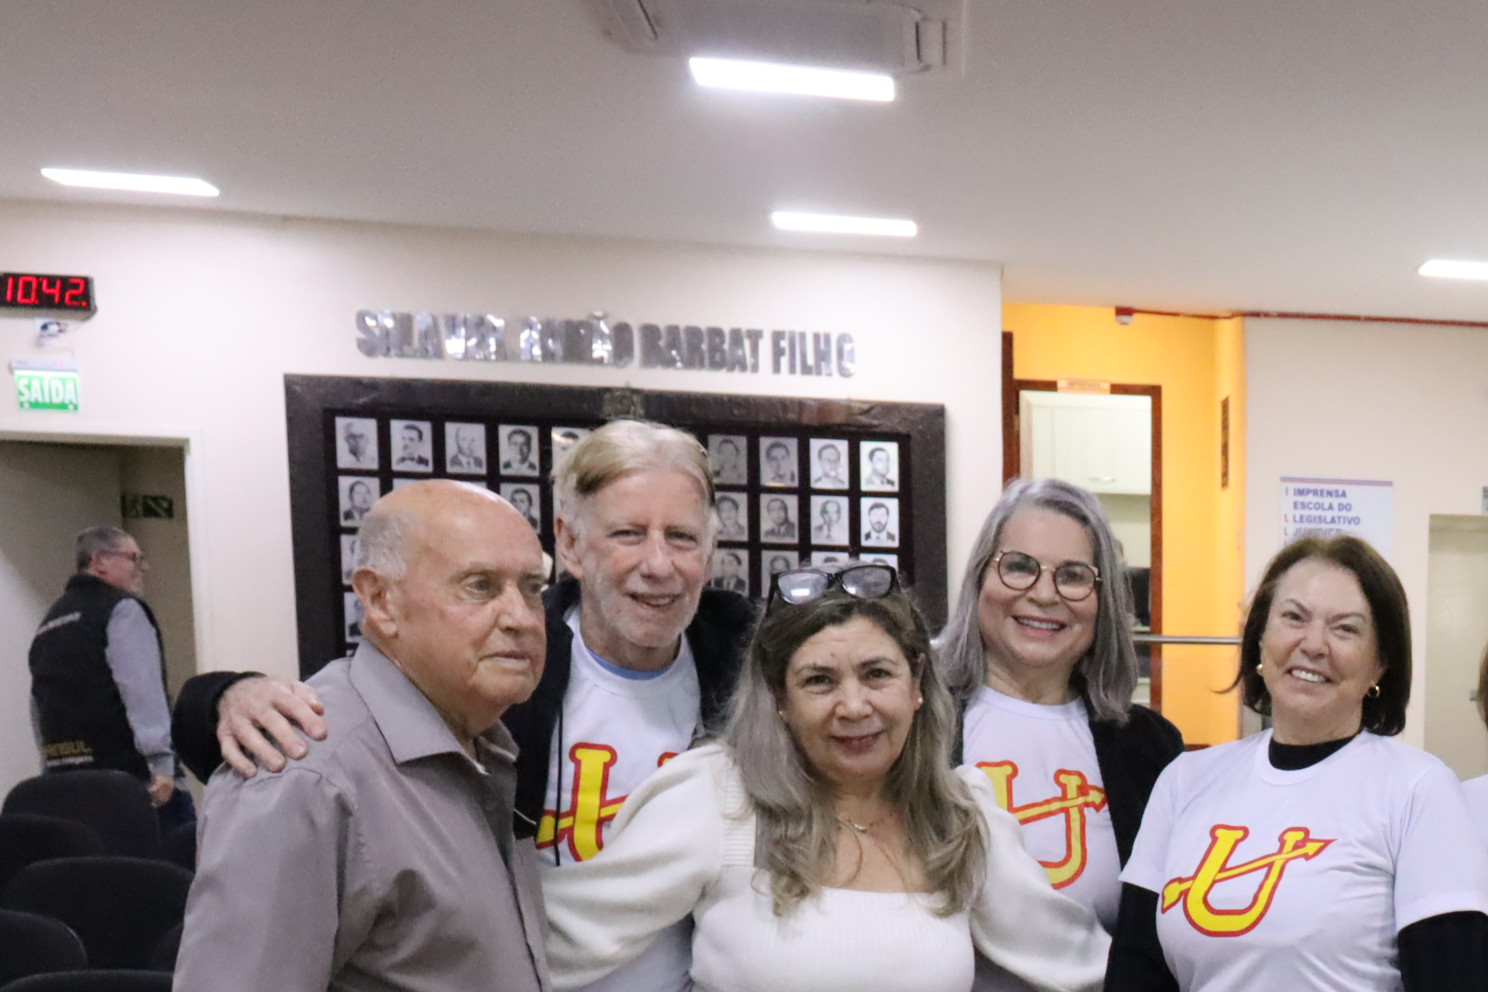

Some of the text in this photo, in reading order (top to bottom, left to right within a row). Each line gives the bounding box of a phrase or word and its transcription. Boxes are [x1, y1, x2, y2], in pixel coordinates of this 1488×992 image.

[771, 329, 856, 378] FILHO
[1293, 487, 1347, 498] IMPRENSA
[1293, 501, 1352, 512] ESCOLA DO
[1293, 514, 1361, 526] LEGISLATIVO
